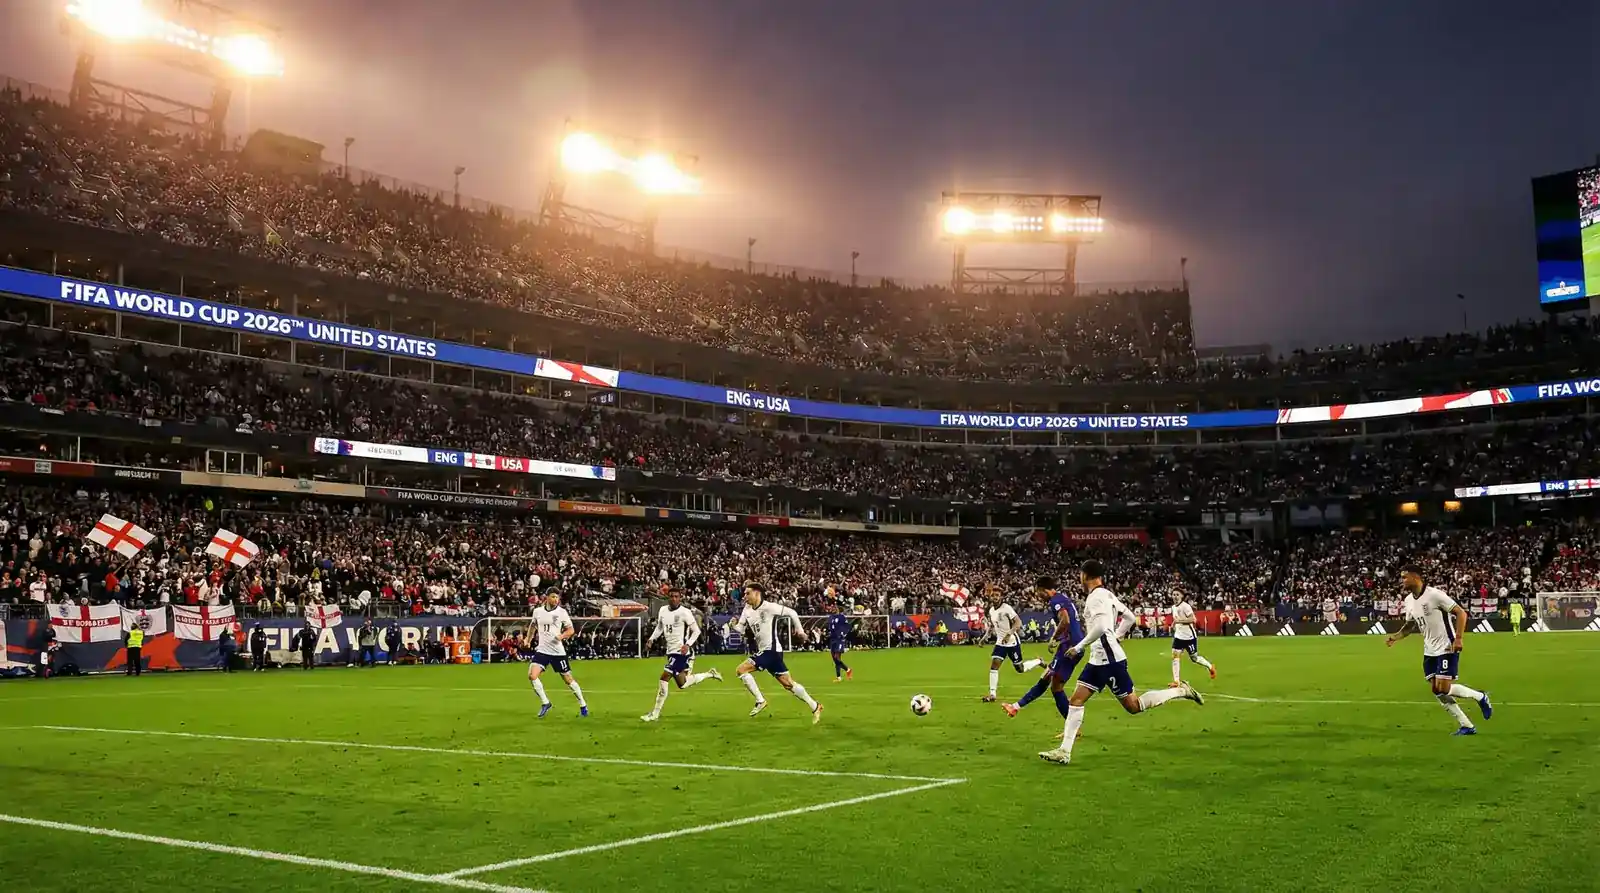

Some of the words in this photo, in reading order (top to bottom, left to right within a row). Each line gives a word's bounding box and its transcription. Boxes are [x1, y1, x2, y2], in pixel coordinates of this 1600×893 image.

[61, 281, 110, 305] FIFA
[115, 289, 195, 318] WORLD
[199, 304, 239, 325] CUP
[308, 322, 374, 347] UNITED
[376, 334, 437, 357] STATES
[1538, 382, 1573, 398] FIFA
[726, 389, 751, 407] ENG
[753, 397, 765, 409] vs
[766, 395, 791, 413] USA
[940, 413, 968, 426] FIFA
[969, 414, 1015, 427] WORLD
[1016, 416, 1043, 428] CUP
[1088, 416, 1138, 428] UNITED
[1140, 415, 1189, 428] STATES
[434, 451, 458, 464] ENG
[501, 458, 523, 471] USA
[1545, 481, 1565, 491] ENG
[397, 491, 413, 499] FIFA
[413, 492, 439, 501] WORLD
[440, 494, 453, 502] CUP
[1442, 659, 1449, 670] 8
[1109, 676, 1118, 690] 2
